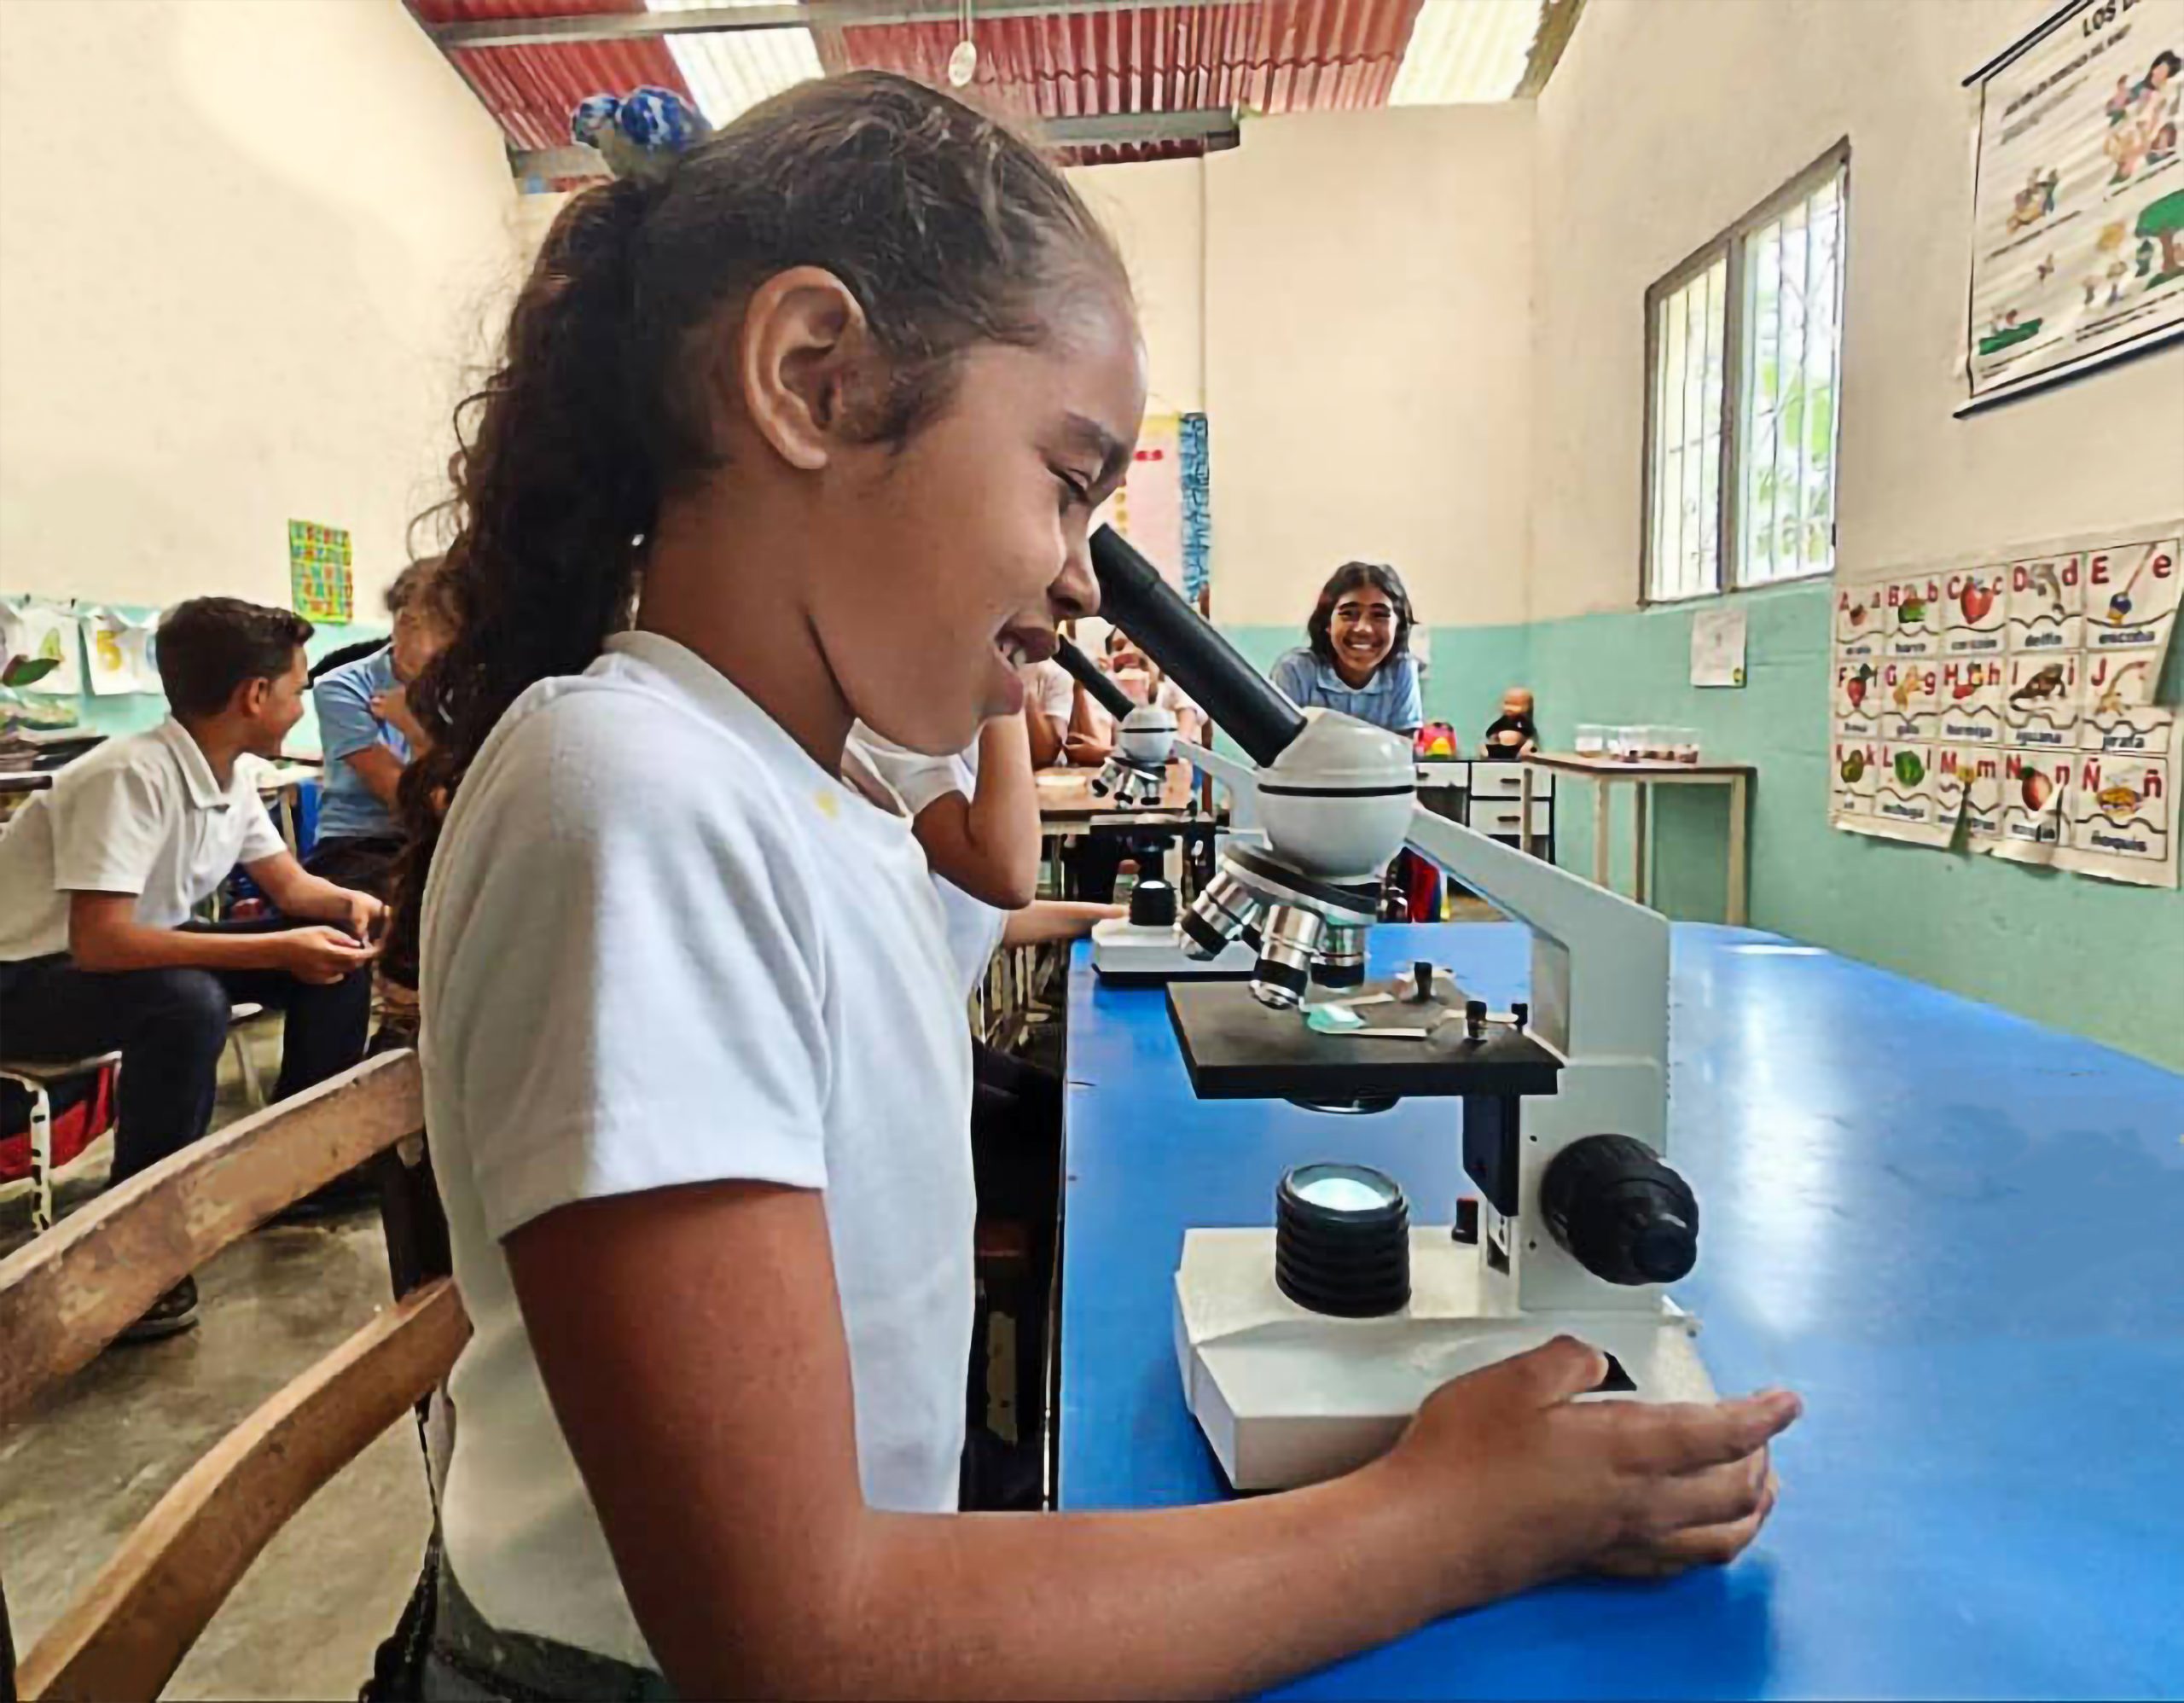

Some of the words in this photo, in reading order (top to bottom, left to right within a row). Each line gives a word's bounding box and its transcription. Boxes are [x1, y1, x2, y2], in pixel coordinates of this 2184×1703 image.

[2013, 566, 2027, 592] D
[2062, 558, 2078, 586] d
[2092, 555, 2110, 584] E
[2153, 555, 2172, 578] e
[1839, 591, 1850, 611] A
[1927, 579, 1938, 602] b
[1948, 576, 1960, 600] C
[1885, 664, 1897, 687] G
[1924, 671, 1937, 695] g
[1944, 663, 1959, 686] H
[1989, 662, 2001, 685] h
[2068, 658, 2075, 685] i
[2091, 658, 2107, 686] J
[1883, 745, 1893, 768] L
[1977, 760, 1996, 778] m
[2006, 754, 2022, 780] N
[2055, 766, 2071, 786] n
[2082, 757, 2101, 793] Ñ
[2143, 769, 2162, 798] ñ
